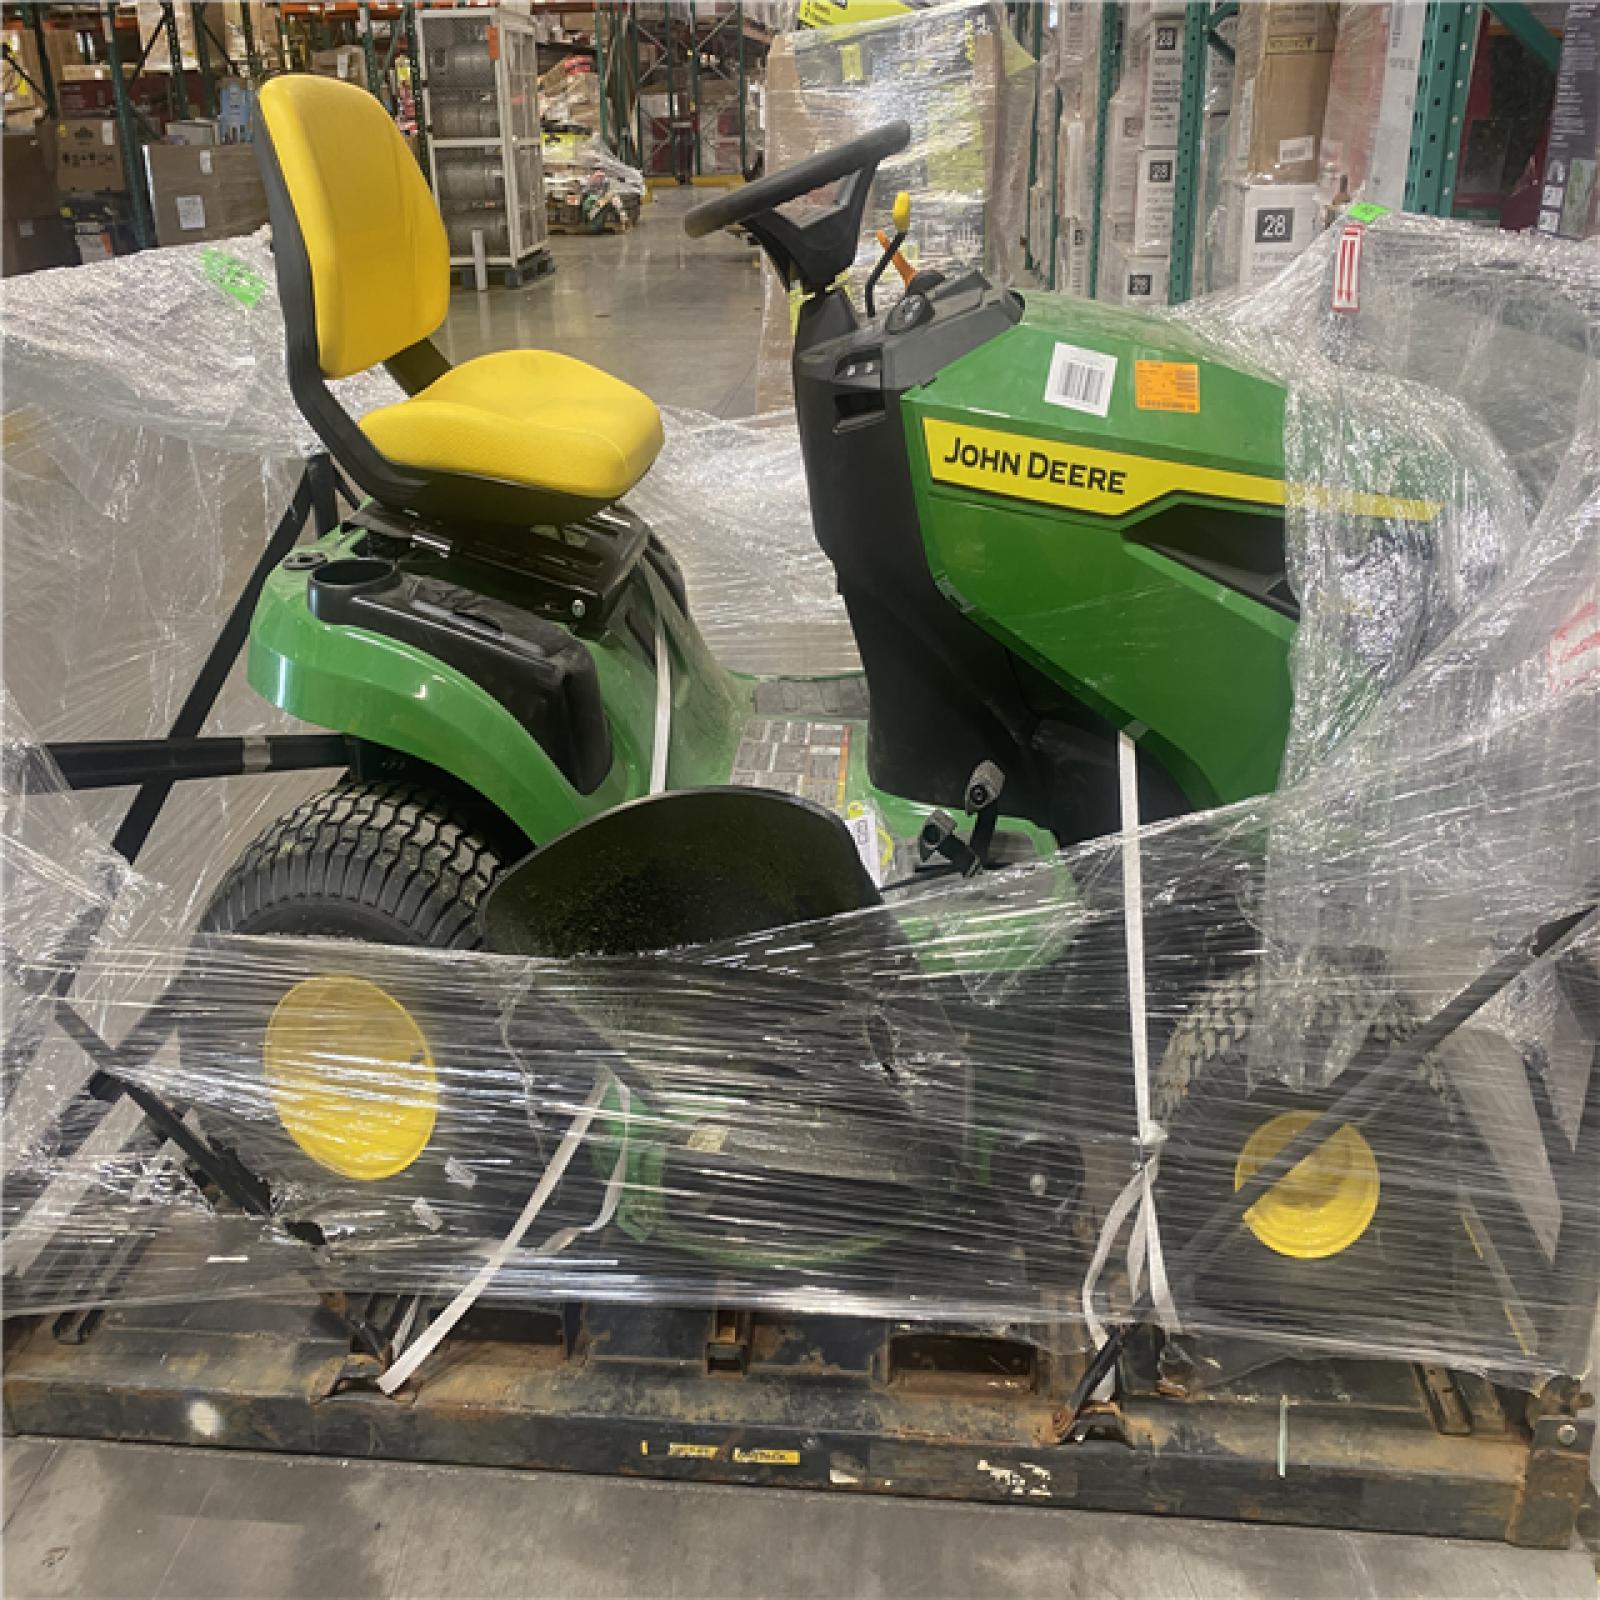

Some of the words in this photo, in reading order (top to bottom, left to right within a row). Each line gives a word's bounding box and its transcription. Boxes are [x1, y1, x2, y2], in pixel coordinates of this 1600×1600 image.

[1262, 214, 1286, 237] 28
[944, 436, 1021, 476] JOHN
[1027, 450, 1127, 495] DEERE
